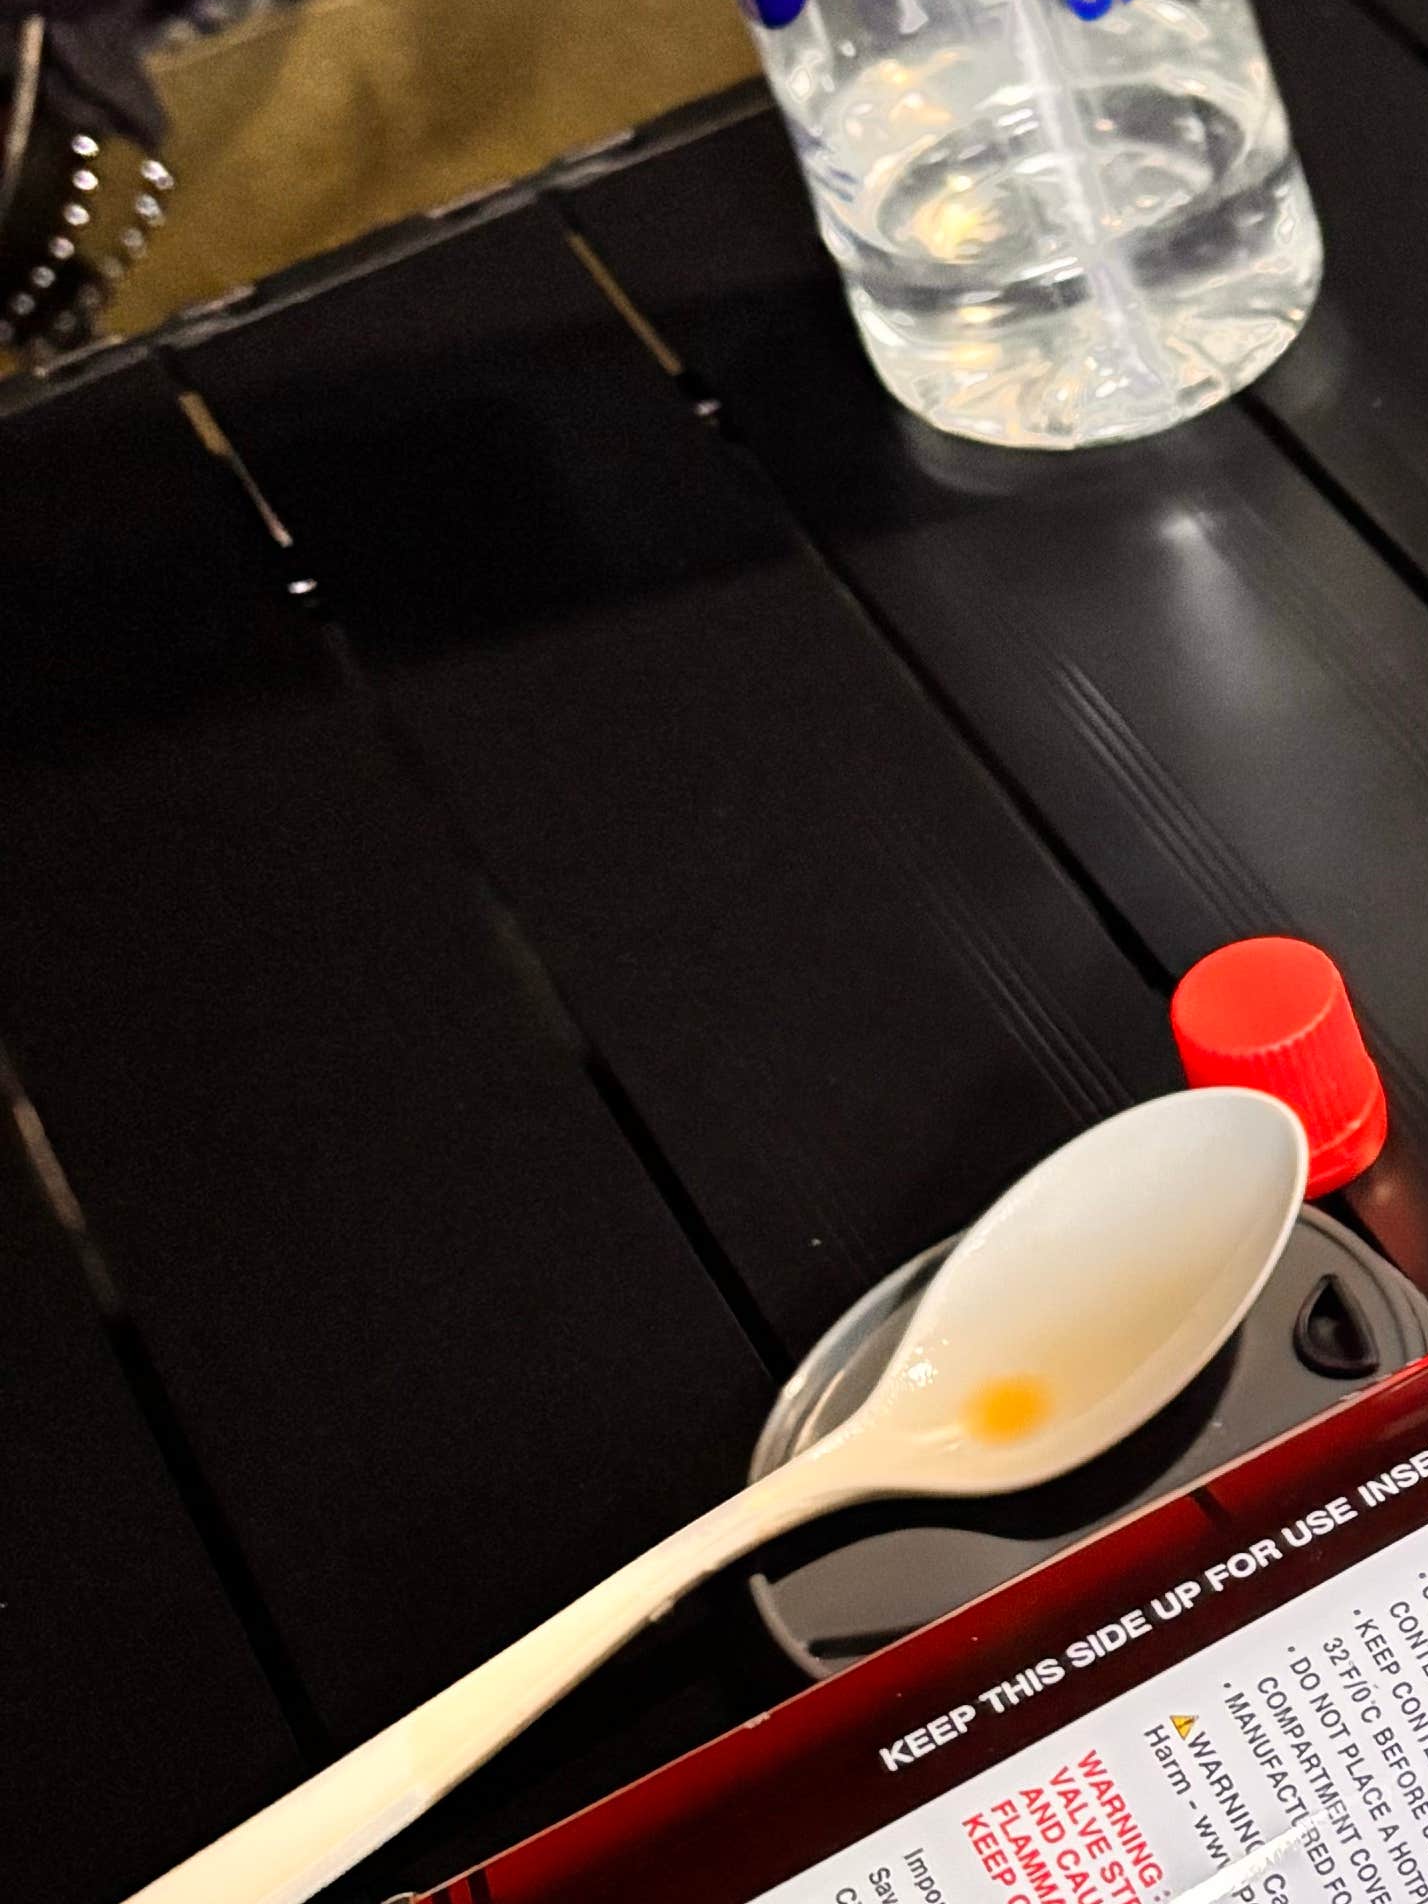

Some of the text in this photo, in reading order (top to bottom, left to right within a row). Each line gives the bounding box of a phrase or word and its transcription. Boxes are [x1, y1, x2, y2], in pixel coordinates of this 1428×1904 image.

[879, 1704, 976, 1772] KEEP
[978, 1658, 1066, 1713] THIS
[1065, 1609, 1153, 1668] SIDE
[1150, 1580, 1202, 1620] UP
[1204, 1538, 1283, 1592] FOR
[1280, 1496, 1359, 1548] USE
[1354, 1618, 1401, 1675] KEEP
[1143, 1723, 1192, 1796] Harm
[1257, 1676, 1363, 1844] COMPARTMENT
[1289, 1656, 1321, 1691] DO
[1309, 1692, 1351, 1740] NOT
[1336, 1742, 1392, 1822] PLACE
[1377, 1824, 1400, 1843] A
[961, 1813, 1017, 1886] KEEP
[1018, 1787, 1066, 1844] AND
[1049, 1765, 1113, 1860] VALVE
[1077, 1749, 1163, 1888] WARNING
